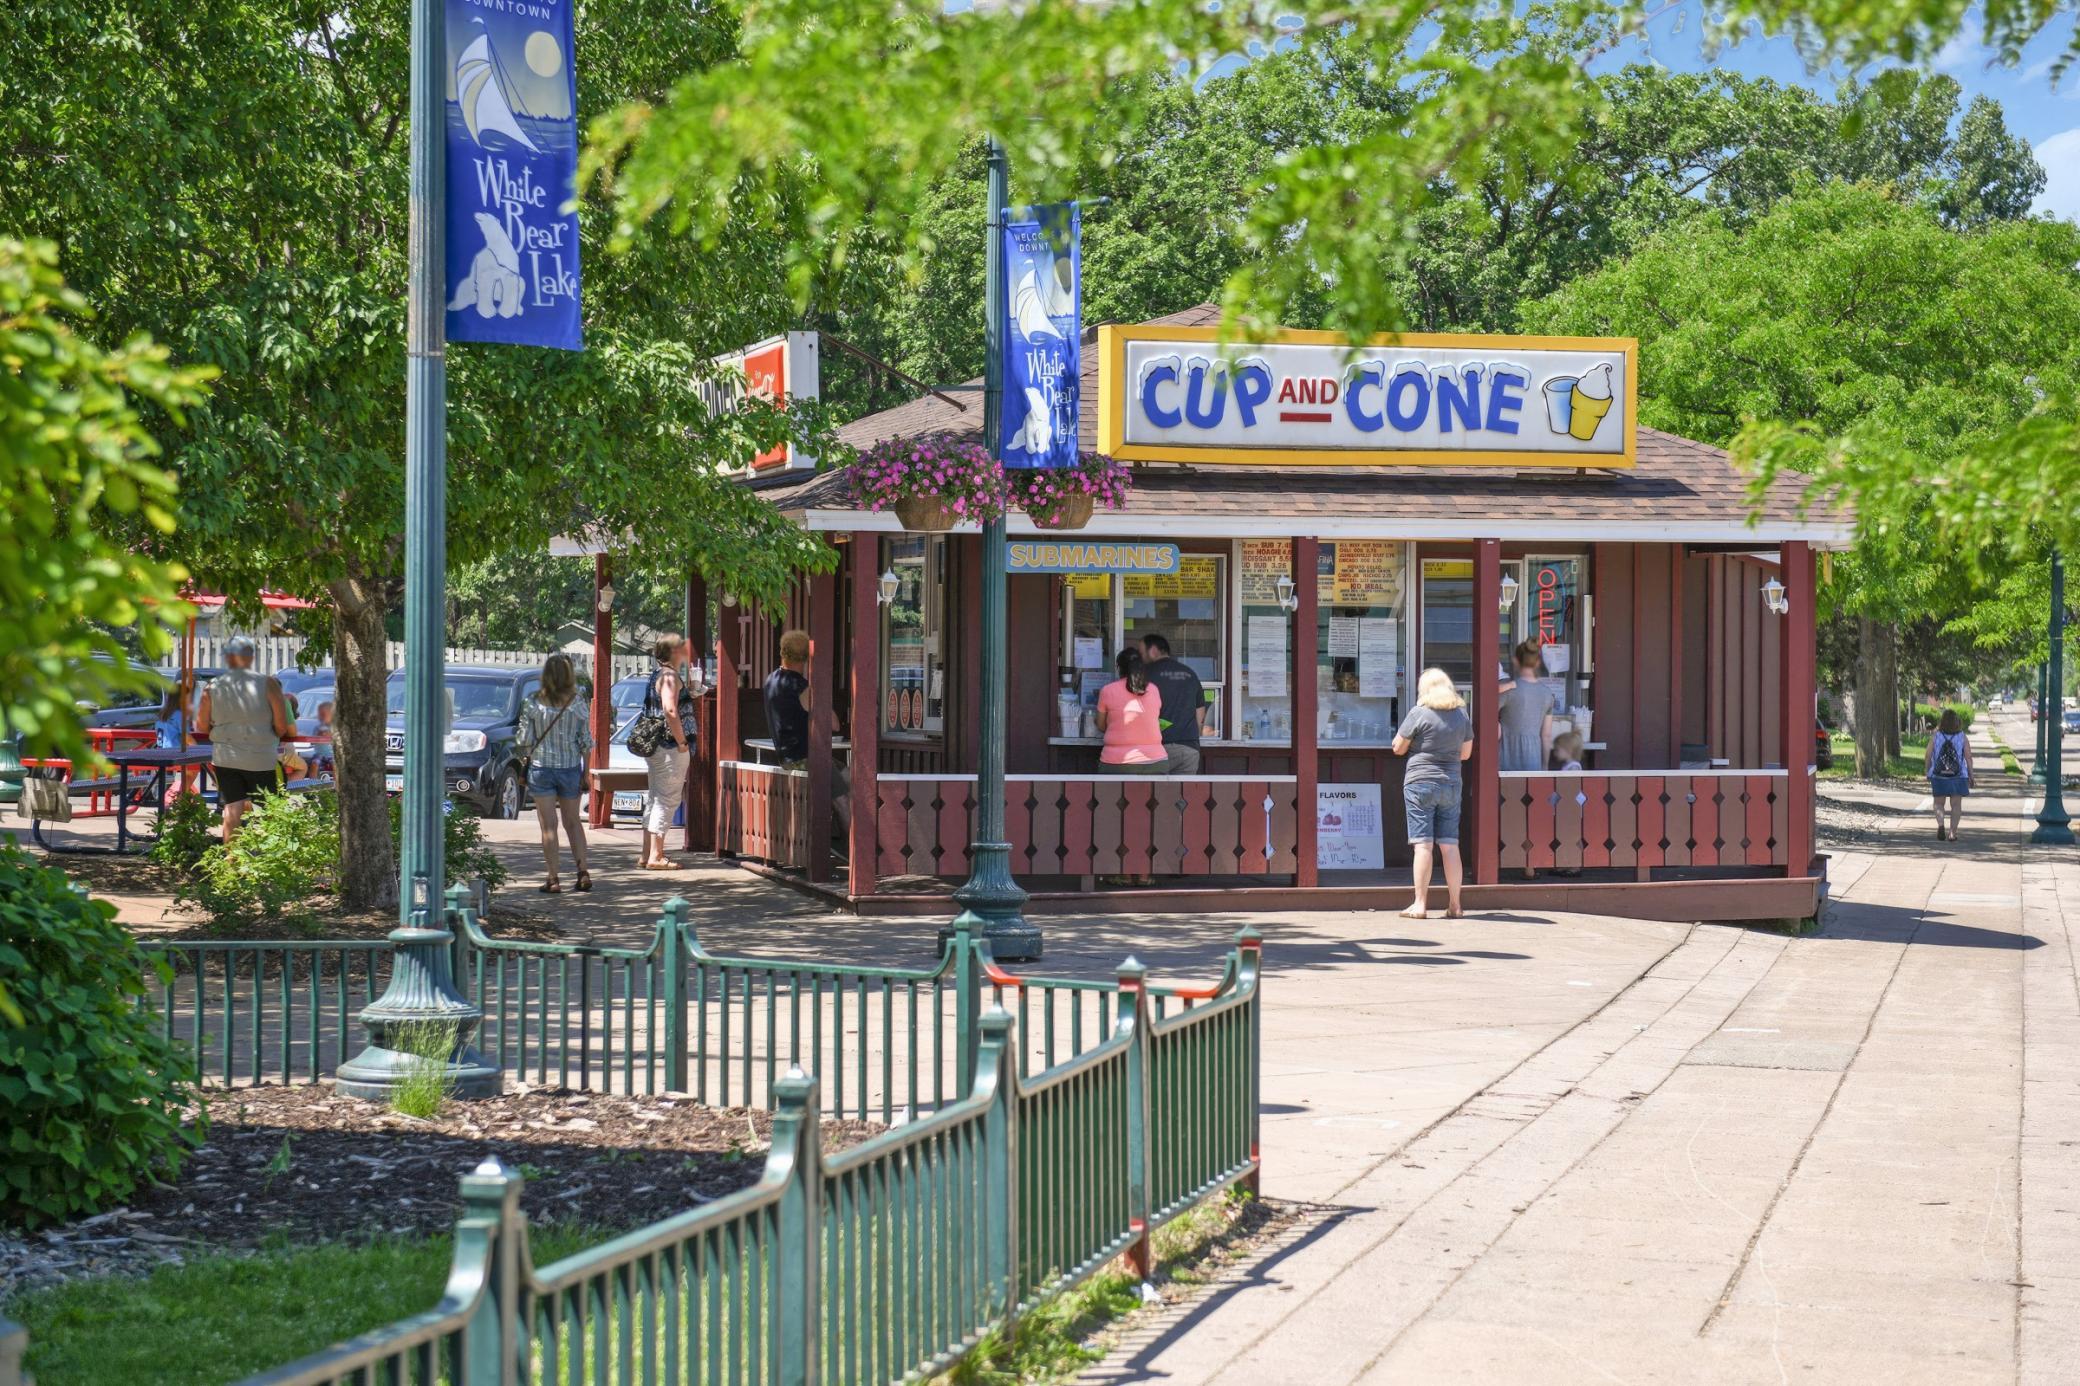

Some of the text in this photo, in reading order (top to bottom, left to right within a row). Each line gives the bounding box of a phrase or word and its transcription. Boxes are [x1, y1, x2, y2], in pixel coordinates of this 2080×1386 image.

[465, 0, 551, 20] WNTOWN
[473, 156, 547, 208] White
[504, 200, 568, 253] Bear
[530, 251, 577, 307] Lake
[1026, 349, 1066, 384] White
[1042, 377, 1075, 408] Bear
[1139, 355, 1532, 435] CUP AND CONE
[1055, 407, 1077, 444] Lake
[1009, 544, 1174, 569] SUBMARINES
[1537, 568, 1557, 645] OPEN
